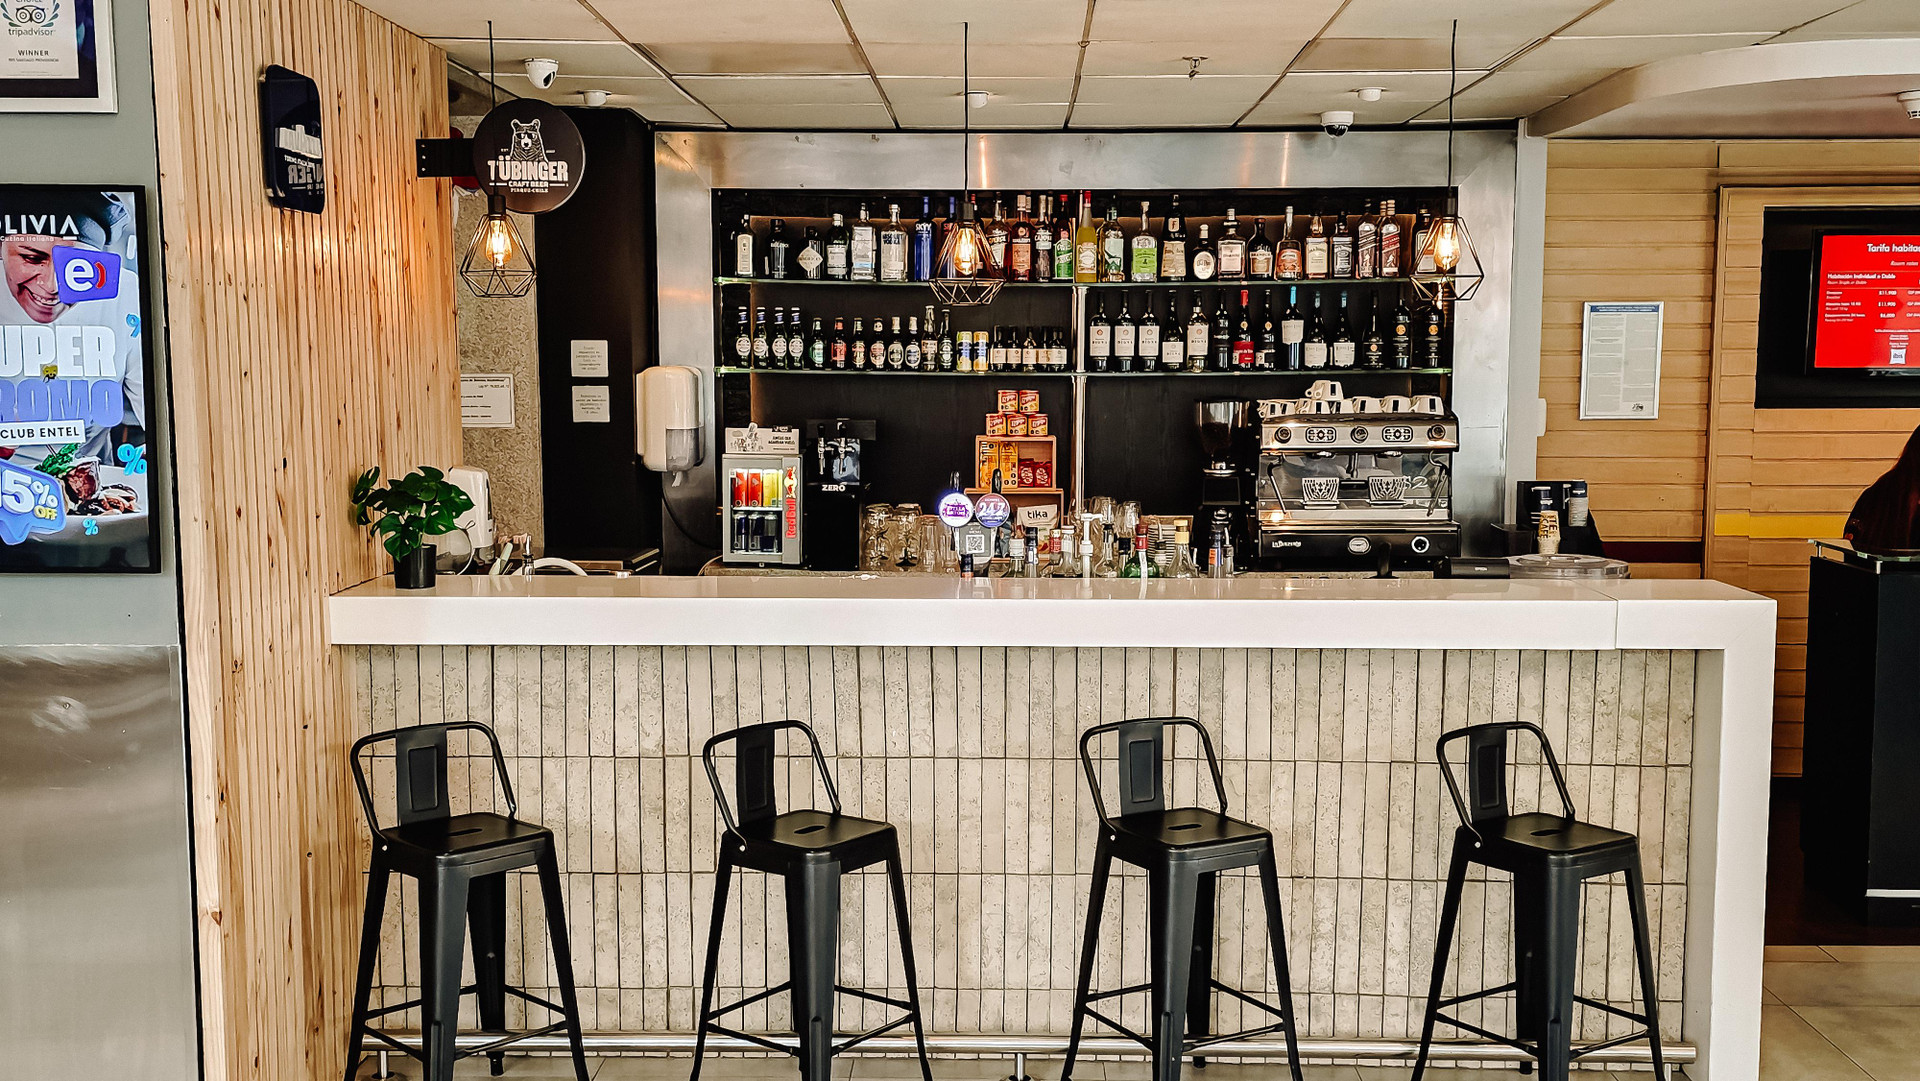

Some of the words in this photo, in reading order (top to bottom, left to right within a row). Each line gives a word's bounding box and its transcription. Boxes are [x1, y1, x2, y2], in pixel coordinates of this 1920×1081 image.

[8, 28, 54, 37] tripadvisor
[487, 155, 569, 181] TÜBINGER
[0, 215, 79, 240] LIVIA
[1867, 243, 1890, 252] Tarifa
[0, 428, 35, 439] CLUB
[40, 426, 80, 438] ENTEL
[0, 469, 58, 514] 5%
[822, 484, 847, 492] ZERO
[1027, 510, 1048, 520] tika
